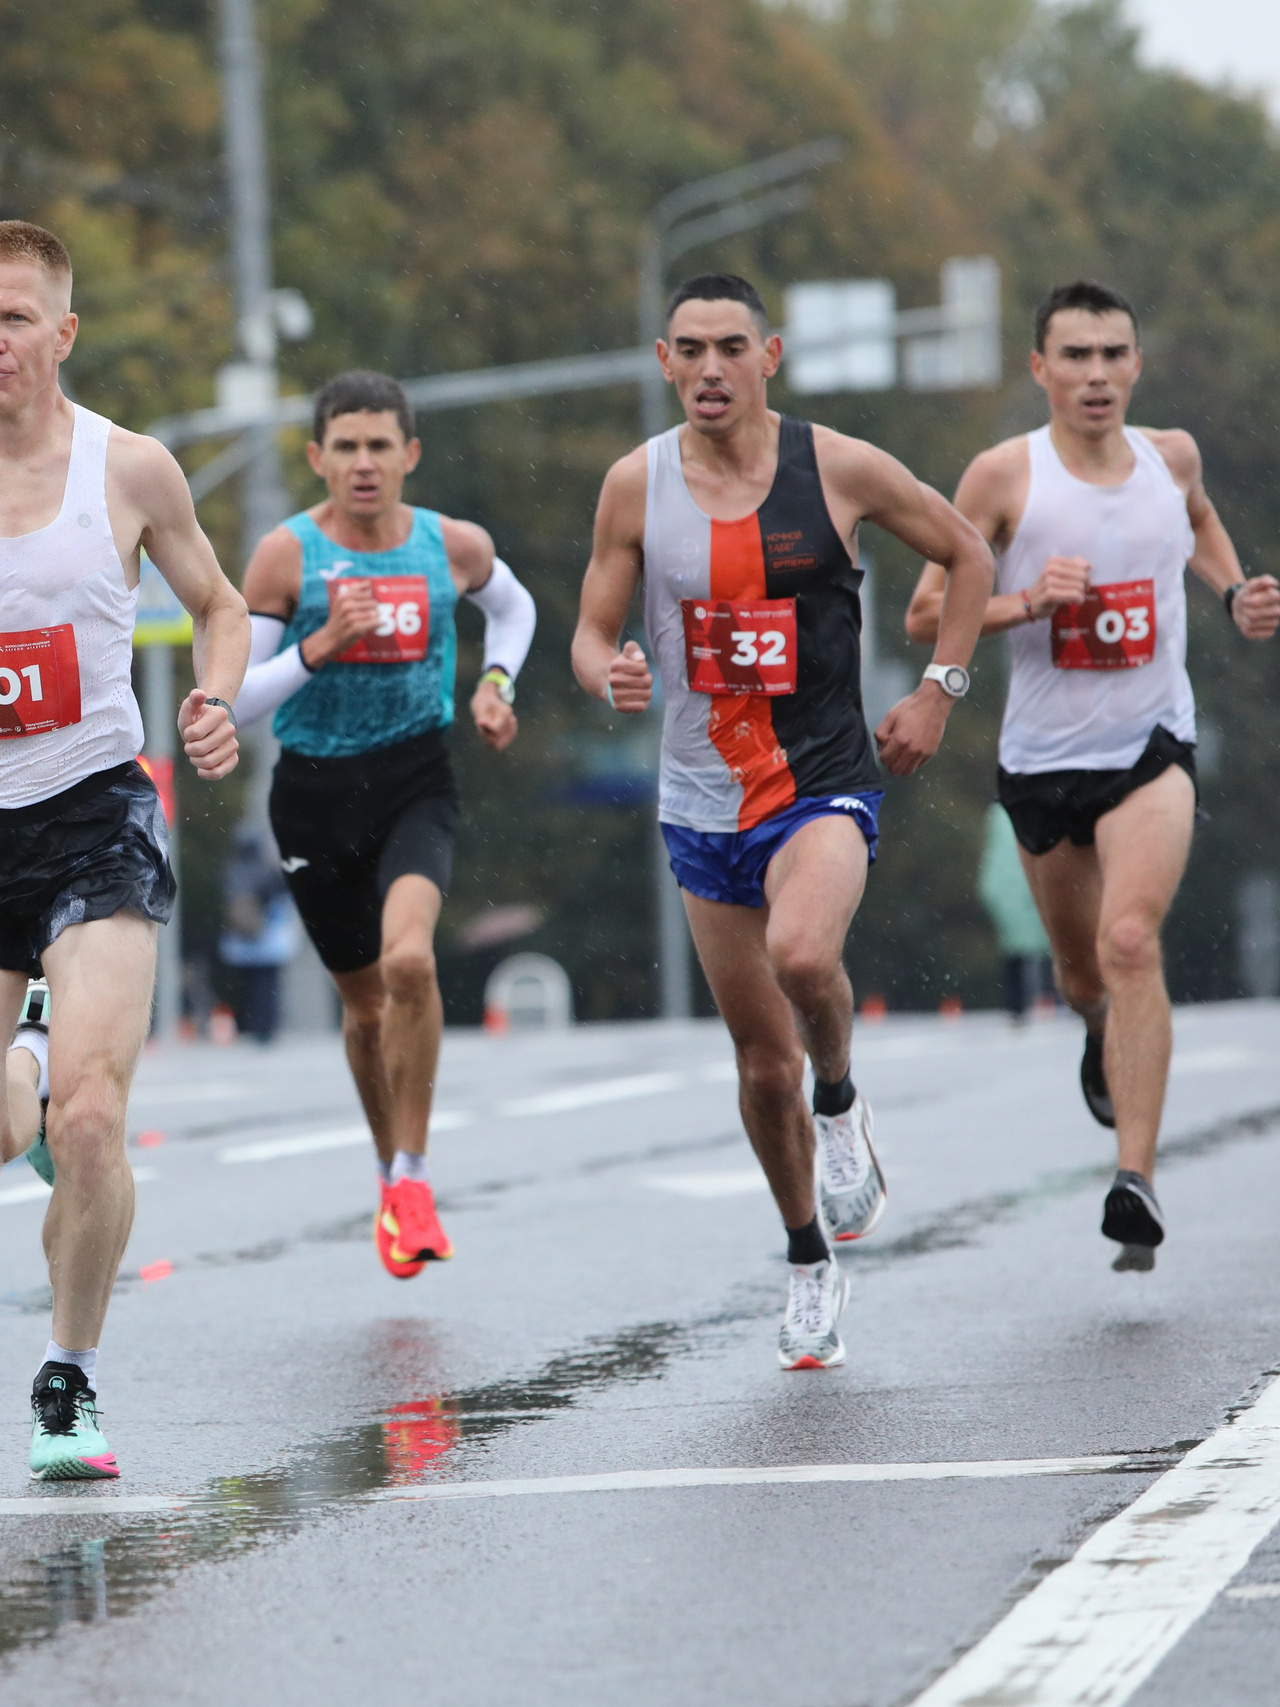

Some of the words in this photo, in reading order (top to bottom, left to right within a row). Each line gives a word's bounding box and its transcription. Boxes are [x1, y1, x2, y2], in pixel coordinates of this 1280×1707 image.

[374, 601, 422, 636] 36
[1095, 606, 1150, 643] 03
[730, 630, 787, 666] 32
